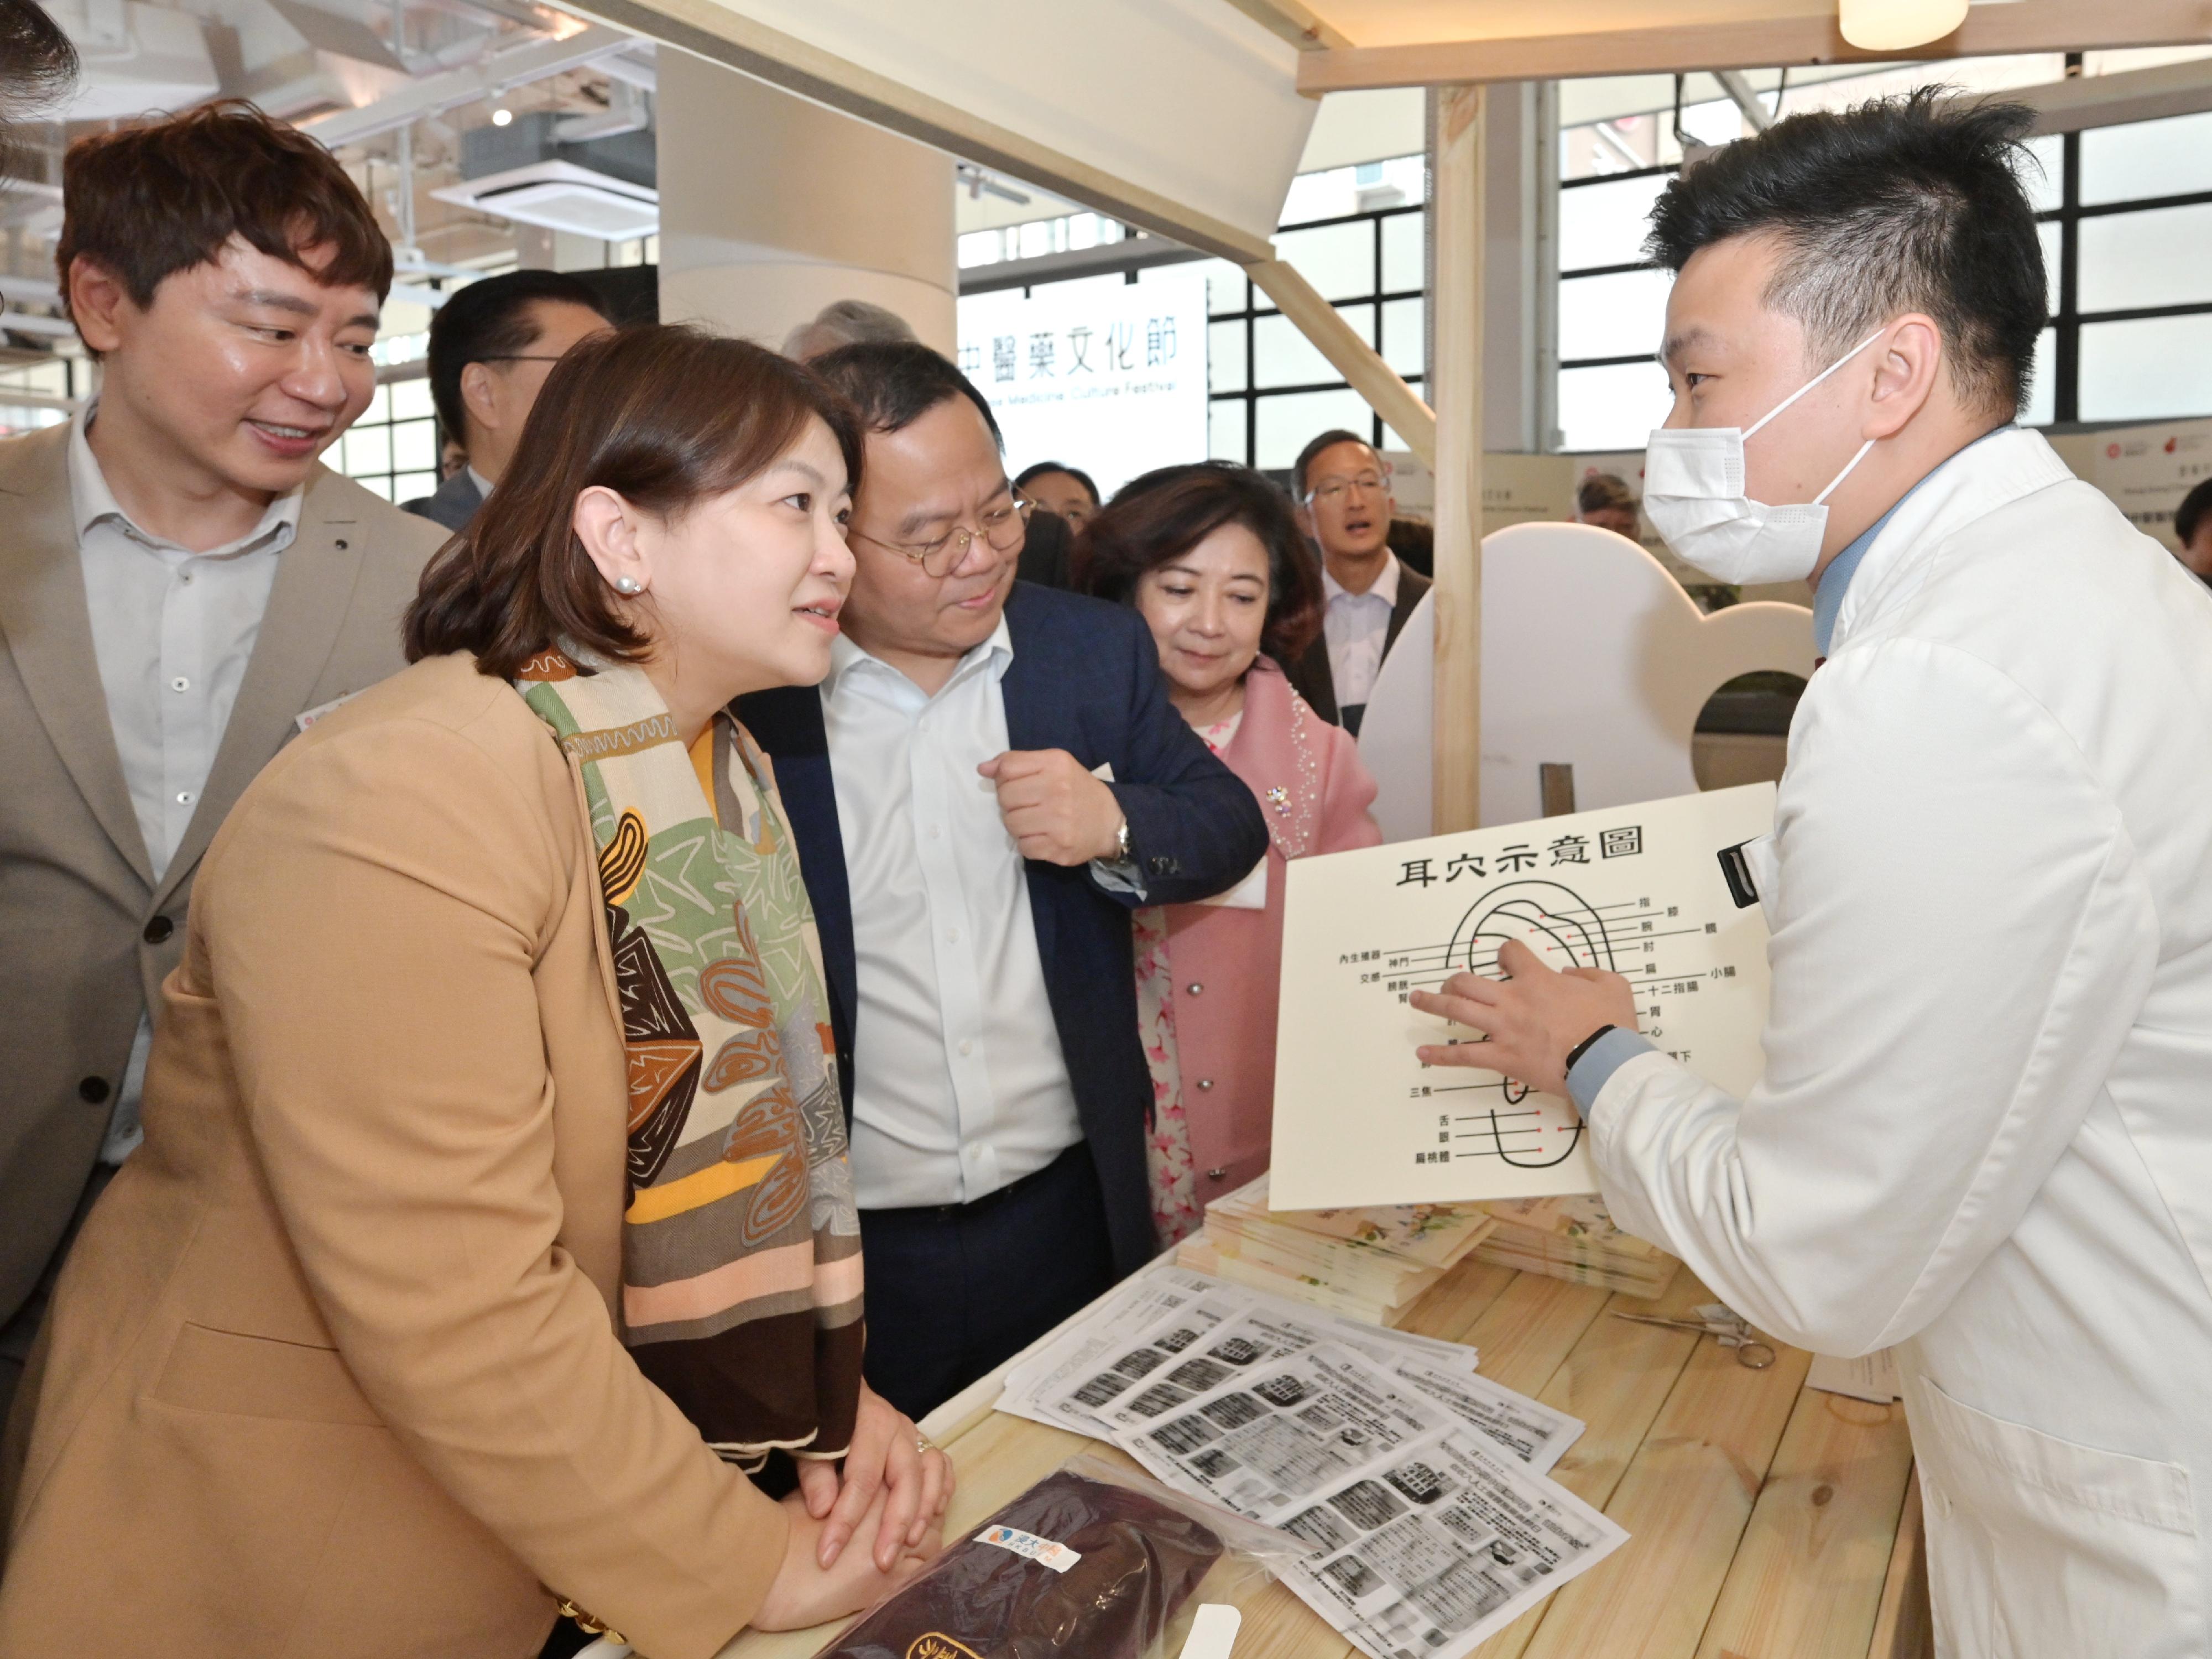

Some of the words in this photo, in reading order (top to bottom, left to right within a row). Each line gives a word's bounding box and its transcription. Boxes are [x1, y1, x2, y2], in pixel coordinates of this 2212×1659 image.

[958, 316, 1176, 382] 中醫藥文化節
[1009, 393, 1063, 405] Medicine
[1070, 386, 1119, 399] Culture
[1125, 380, 1176, 393] Festival
[1397, 826, 1642, 888] 耳穴示意圖
[1389, 957, 1408, 967] 神門
[1361, 972, 1380, 983] 交感
[1712, 966, 1736, 978] 小腸
[1648, 980, 1699, 996] 十二指腸
[1651, 1026, 1662, 1037] 心
[1411, 1087, 1431, 1097] 三焦
[1439, 1115, 1449, 1126] 舌
